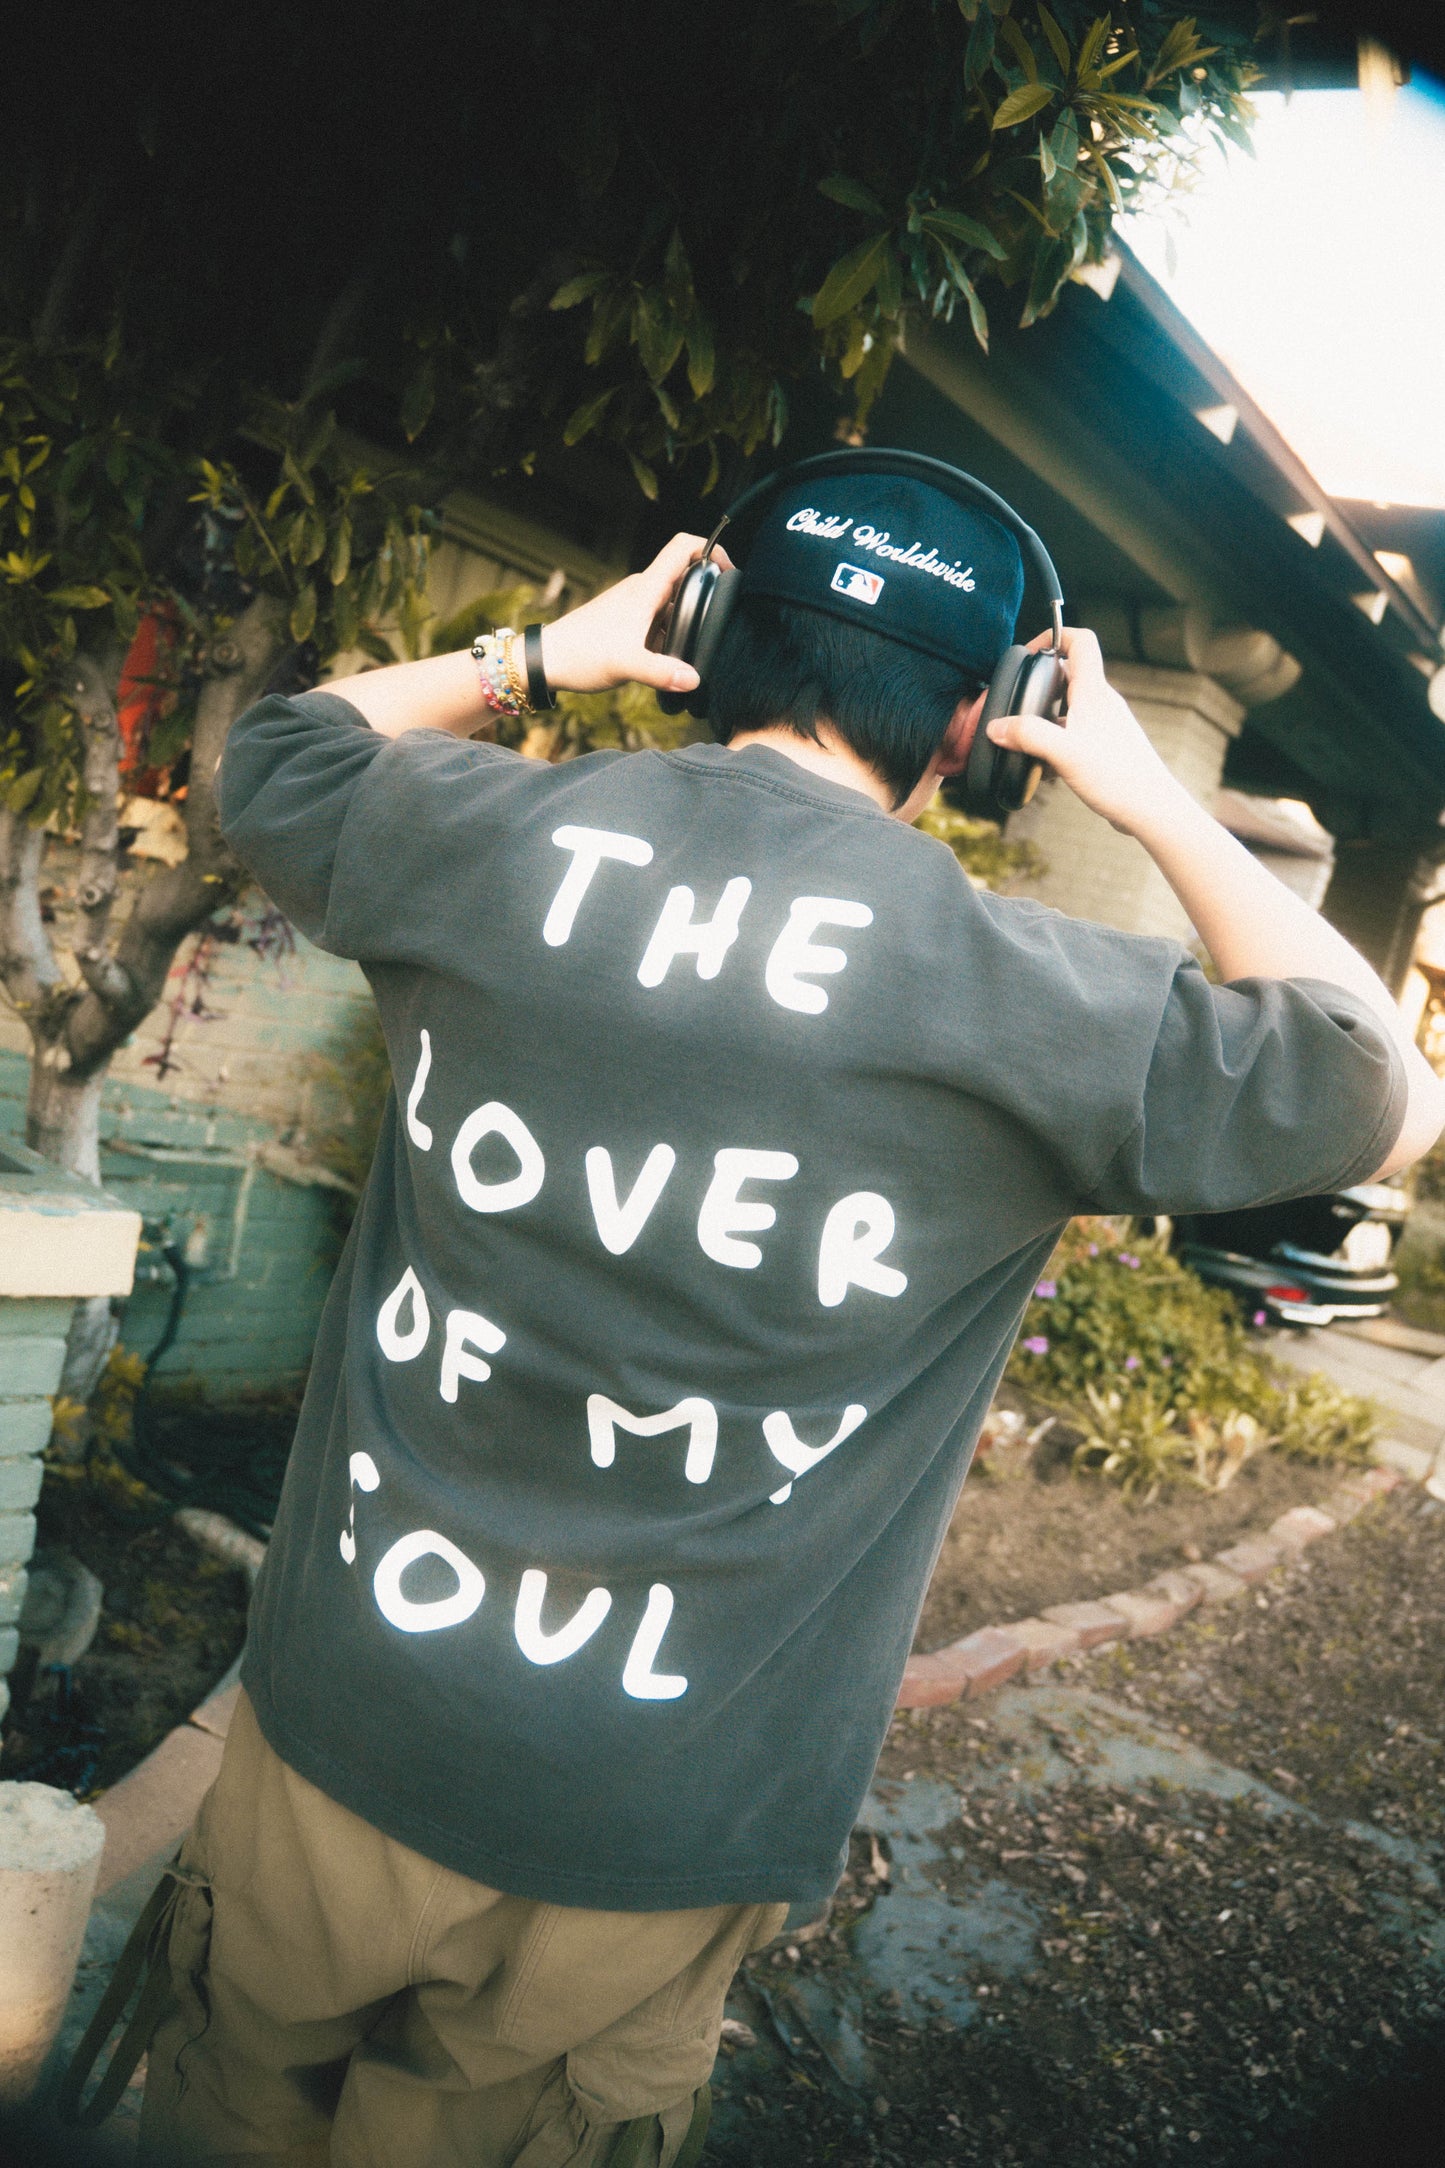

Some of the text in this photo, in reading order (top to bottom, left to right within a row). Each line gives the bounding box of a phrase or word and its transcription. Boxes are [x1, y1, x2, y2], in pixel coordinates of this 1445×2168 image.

[786, 507, 976, 592] Child Worldwide
[543, 824, 875, 1015] THE
[407, 1029, 908, 1308] LOVER
[376, 1265, 868, 1505] OF MY
